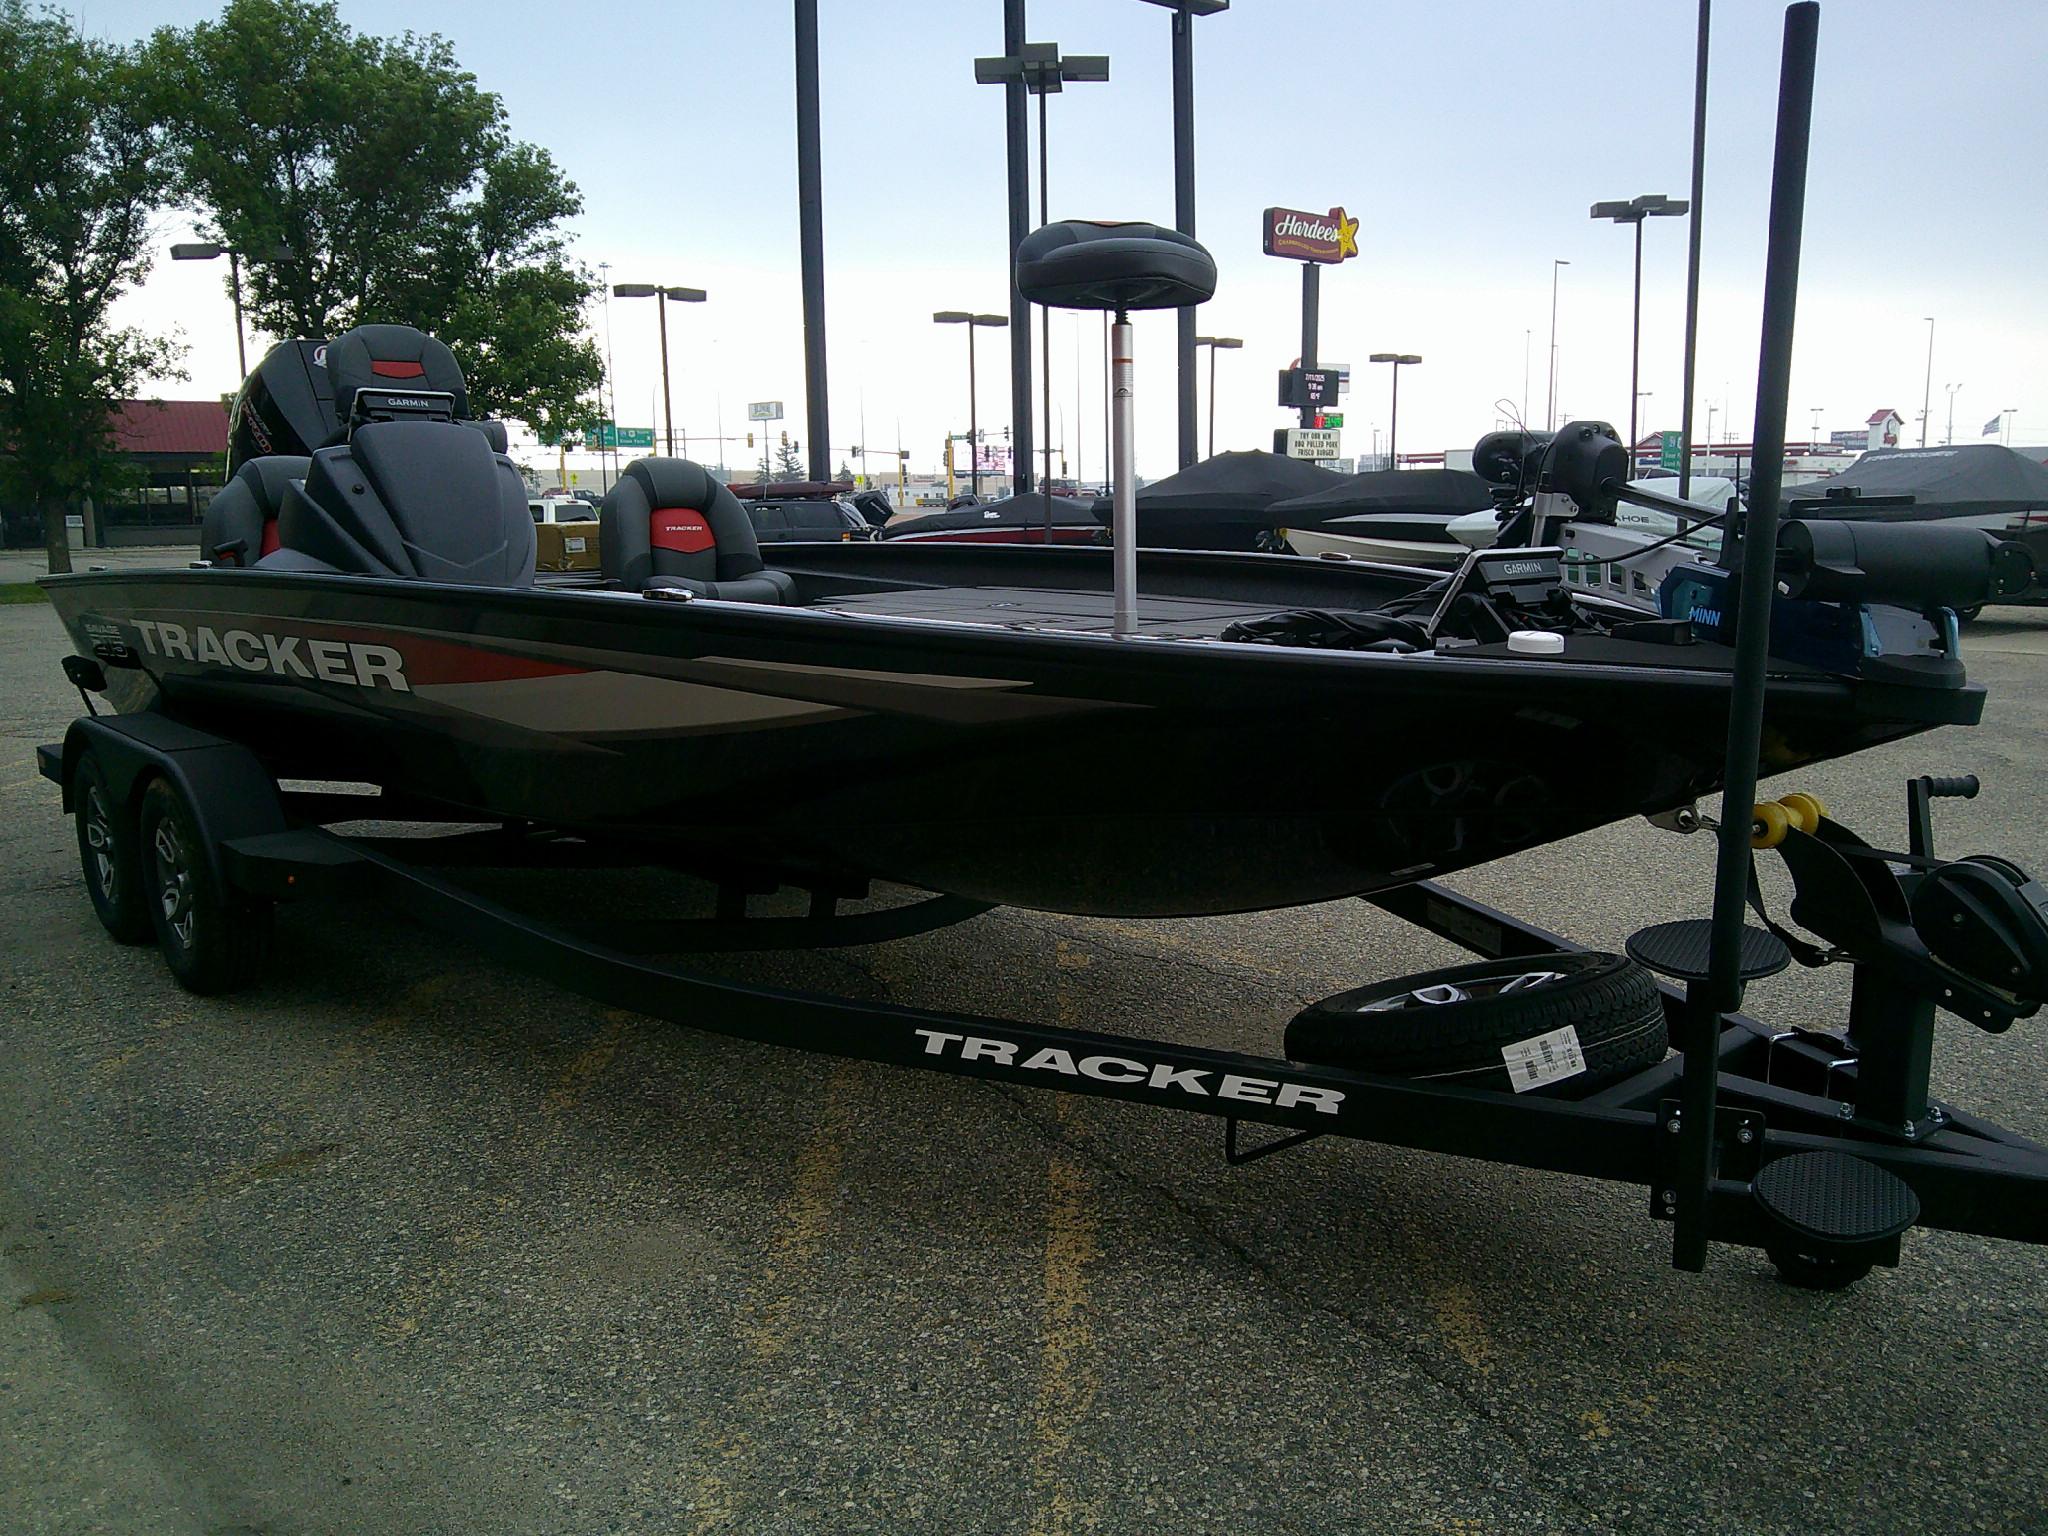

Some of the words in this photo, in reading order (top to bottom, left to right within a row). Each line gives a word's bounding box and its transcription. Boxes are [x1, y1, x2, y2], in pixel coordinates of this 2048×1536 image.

[1275, 214, 1339, 242] Hardee's
[387, 398, 430, 407] GARMIN
[1300, 432, 1310, 440] TRY
[1306, 440, 1324, 448] PULLED
[1325, 440, 1338, 449] PORK
[1297, 448, 1314, 457] FRISCO
[1316, 448, 1334, 457] BURGER
[1503, 562, 1543, 575] GARMIN
[1689, 606, 1721, 627] MINN
[130, 619, 410, 692] TRACKER
[914, 1029, 1346, 1114] TRACKER
